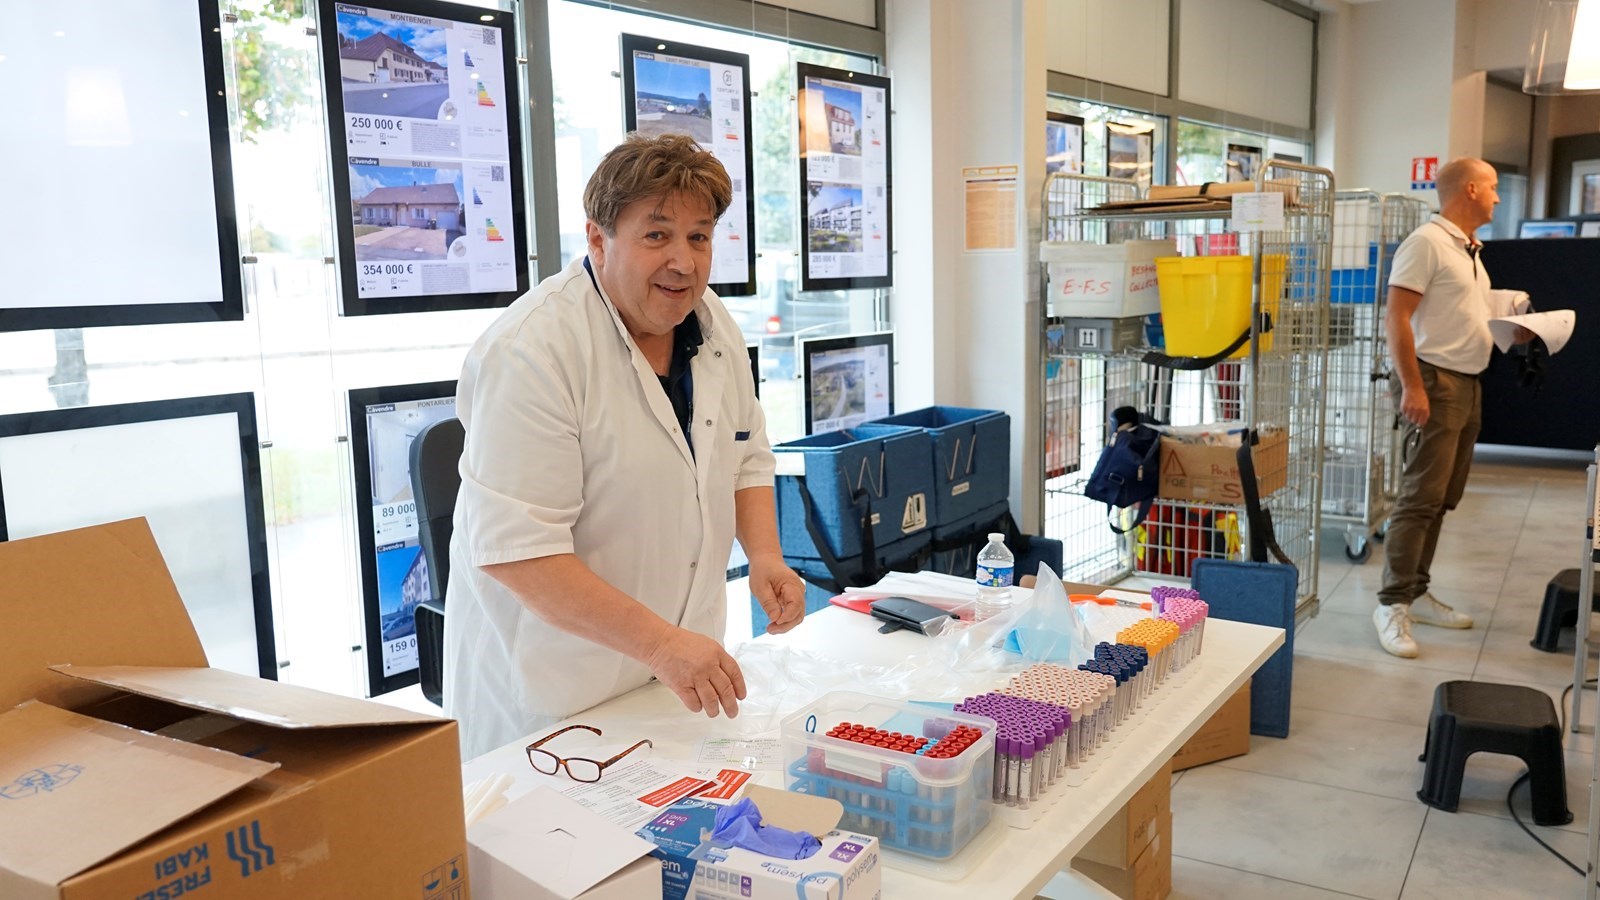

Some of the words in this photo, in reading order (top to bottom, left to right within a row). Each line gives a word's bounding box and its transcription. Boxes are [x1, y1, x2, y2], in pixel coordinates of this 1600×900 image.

[390, 13, 432, 25] MONTBENOIT
[351, 117, 371, 129] 250
[374, 119, 394, 130] 000
[396, 120, 403, 131] €
[411, 160, 432, 168] BULLE
[363, 264, 382, 275] 354
[385, 264, 404, 275] 000
[406, 263, 413, 274] €
[382, 506, 395, 517] 89
[397, 503, 415, 514] 000
[389, 640, 407, 653] 159
[843, 843, 857, 851] XL
[155, 843, 209, 880] KABI
[767, 866, 828, 885] polysem
[847, 853, 873, 890] polysem
